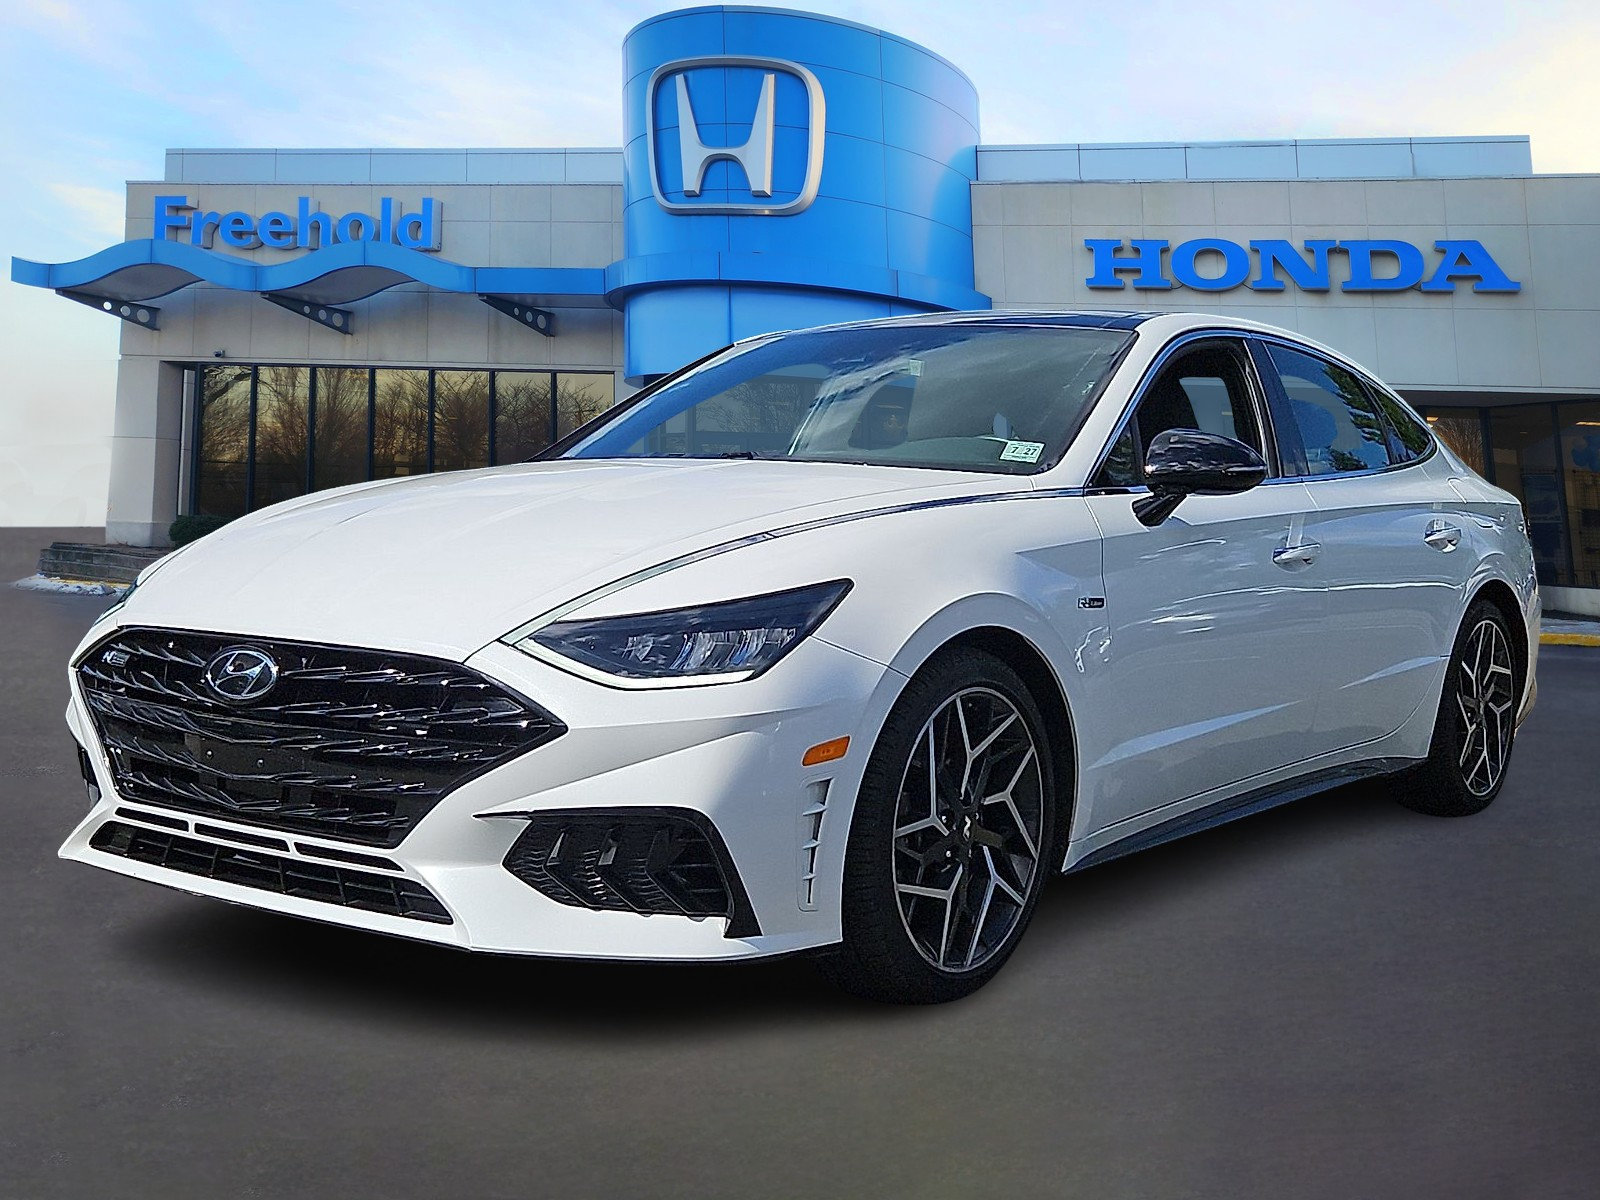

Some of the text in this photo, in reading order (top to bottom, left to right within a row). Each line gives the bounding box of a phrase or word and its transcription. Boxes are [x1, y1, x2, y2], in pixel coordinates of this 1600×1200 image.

[153, 195, 440, 250] Freehold
[1084, 238, 1521, 293] HONDA
[1010, 446, 1038, 456] 7 27
